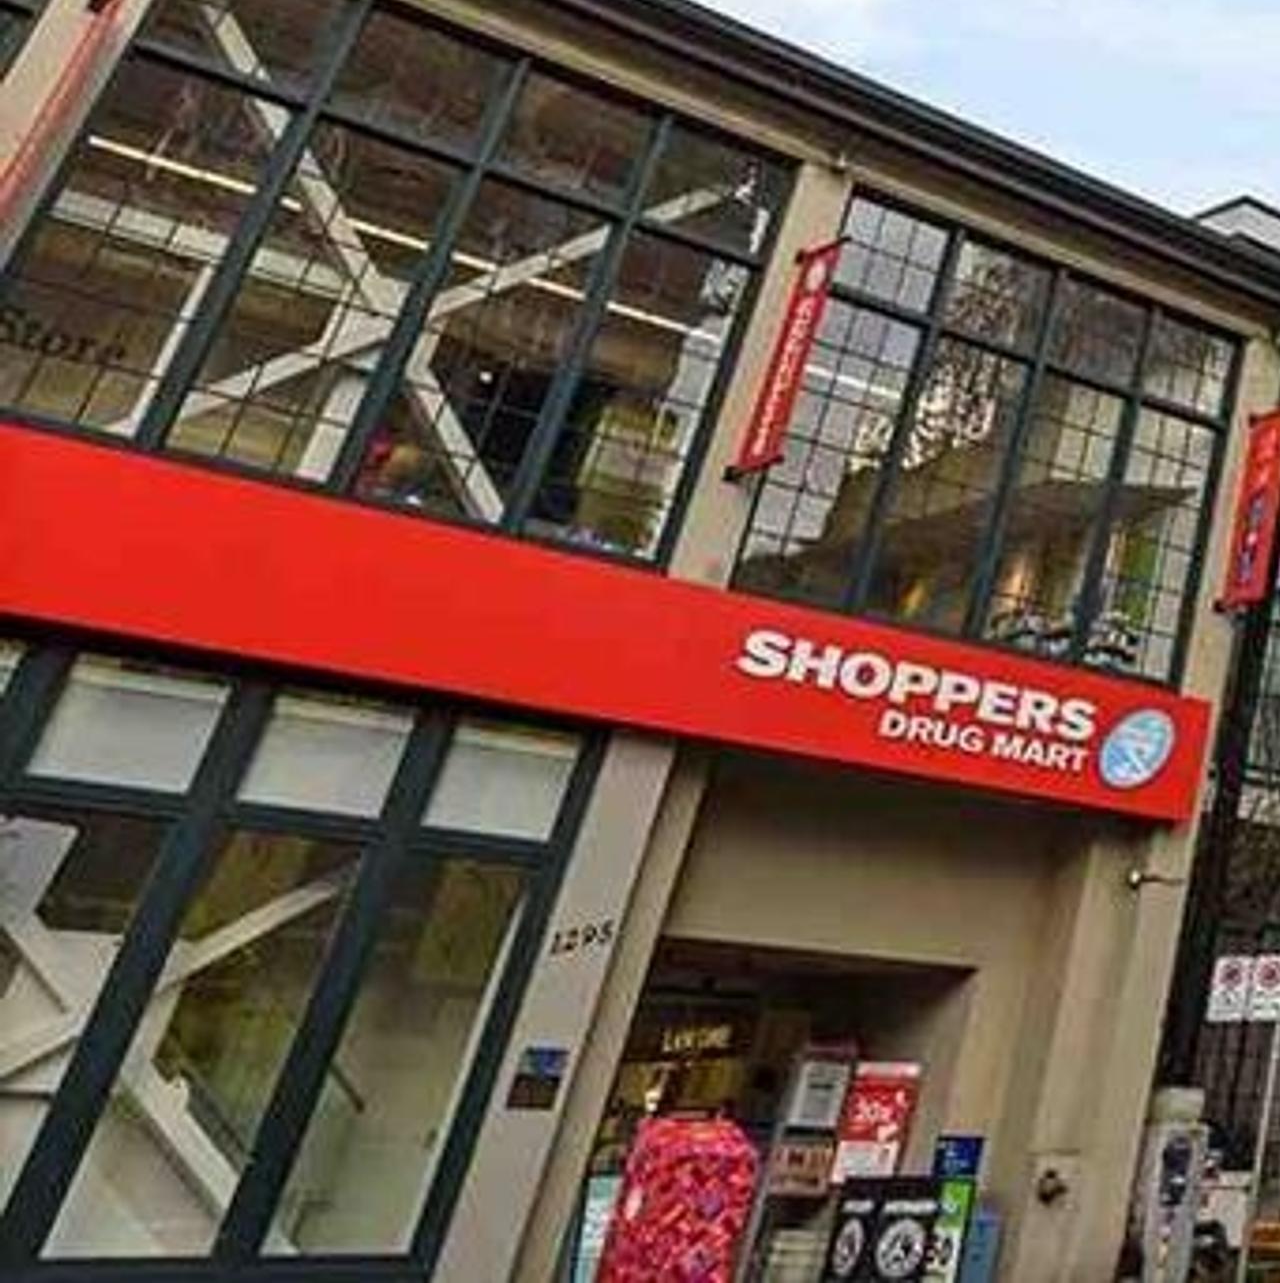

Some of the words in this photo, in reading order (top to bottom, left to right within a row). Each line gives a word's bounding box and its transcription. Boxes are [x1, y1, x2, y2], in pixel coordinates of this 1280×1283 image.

[738, 629, 1096, 741] SHOPPERS
[879, 709, 984, 752] DRUG
[991, 733, 1089, 772] MART
[551, 920, 614, 955] 1295
